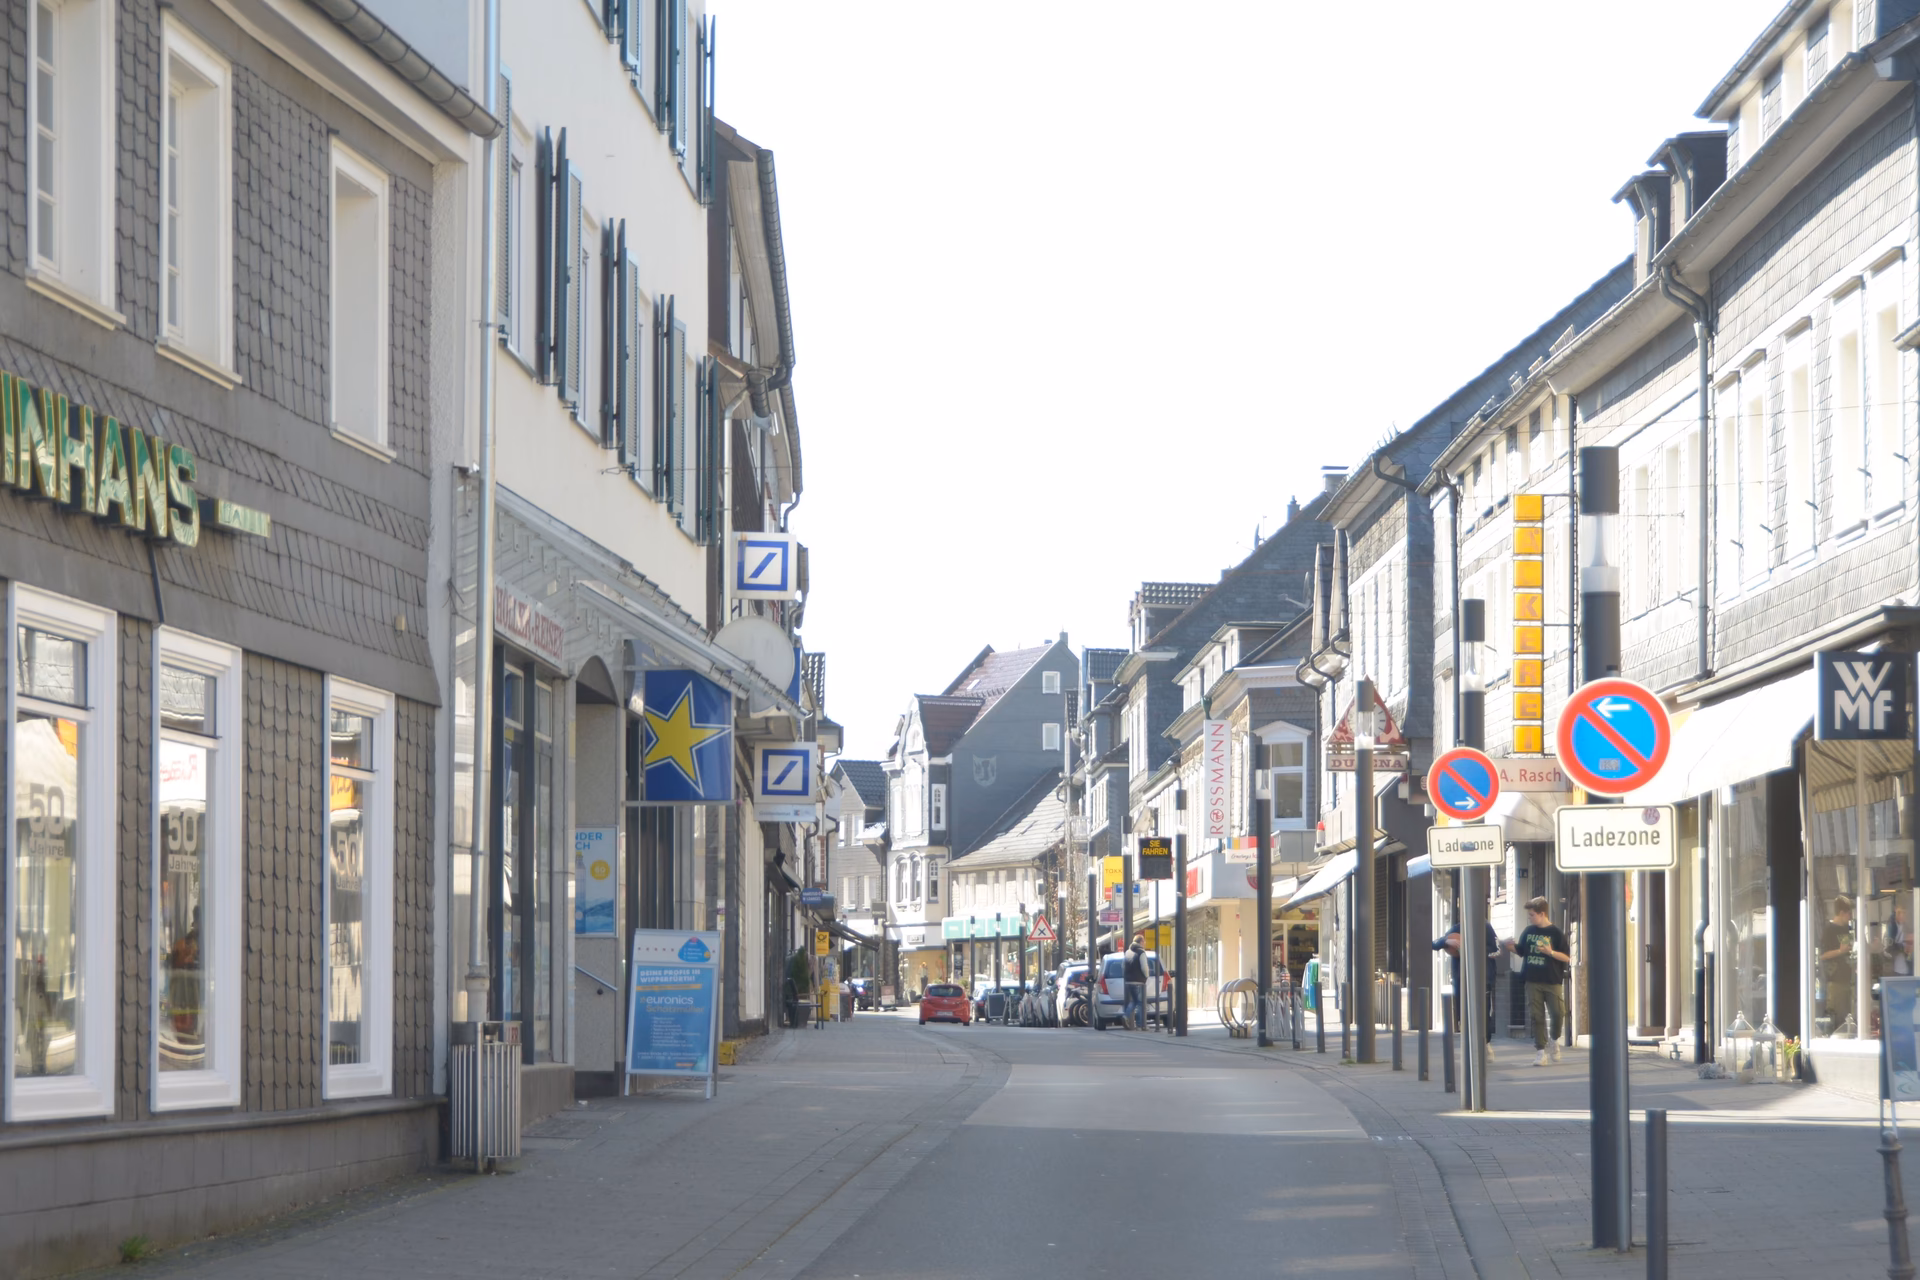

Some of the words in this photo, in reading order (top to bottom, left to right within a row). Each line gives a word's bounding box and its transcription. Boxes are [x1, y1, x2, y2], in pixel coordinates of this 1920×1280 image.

[1518, 497, 1540, 750] ÄCKEREI
[1832, 661, 1892, 730] WMF
[1331, 759, 1404, 769] DUENA
[1210, 723, 1225, 835] ROSSMANN
[1519, 767, 1562, 782] Rasch
[29, 782, 65, 835] 50
[167, 805, 198, 852] 50
[1571, 825, 1661, 848] Ladezone
[29, 839, 65, 860] Jahre
[1142, 847, 1169, 856] FAHREN
[1149, 839, 1161, 848] SIE
[1437, 837, 1494, 853] Ladone
[168, 856, 198, 872] Jahre
[646, 994, 694, 1005] euronics
